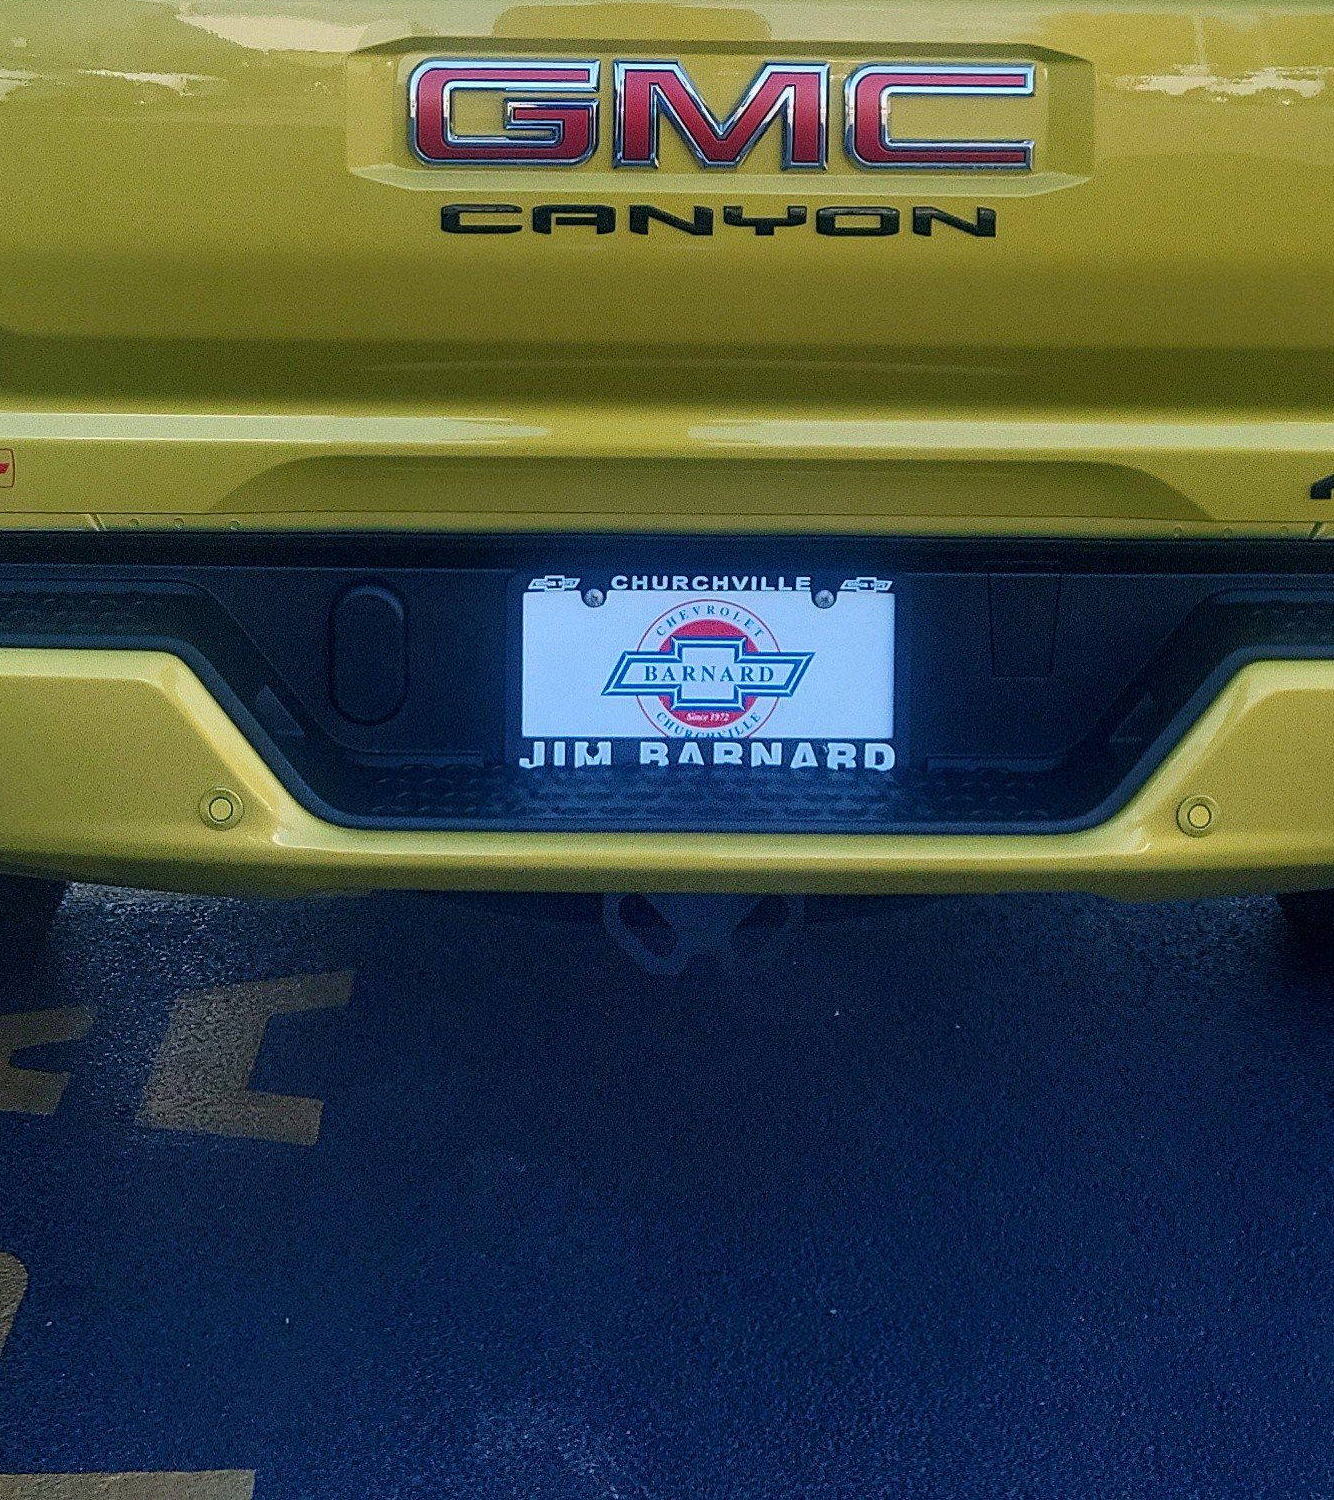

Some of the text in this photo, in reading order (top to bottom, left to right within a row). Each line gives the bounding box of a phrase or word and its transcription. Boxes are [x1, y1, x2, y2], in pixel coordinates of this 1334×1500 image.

[409, 57, 1036, 173] GMC
[440, 203, 997, 237] CANYON
[610, 575, 811, 591] CHURCHVILLE
[656, 605, 764, 636] CHEVROLET
[643, 665, 775, 683] BARNARD
[519, 741, 896, 771] JIM BARNARD
